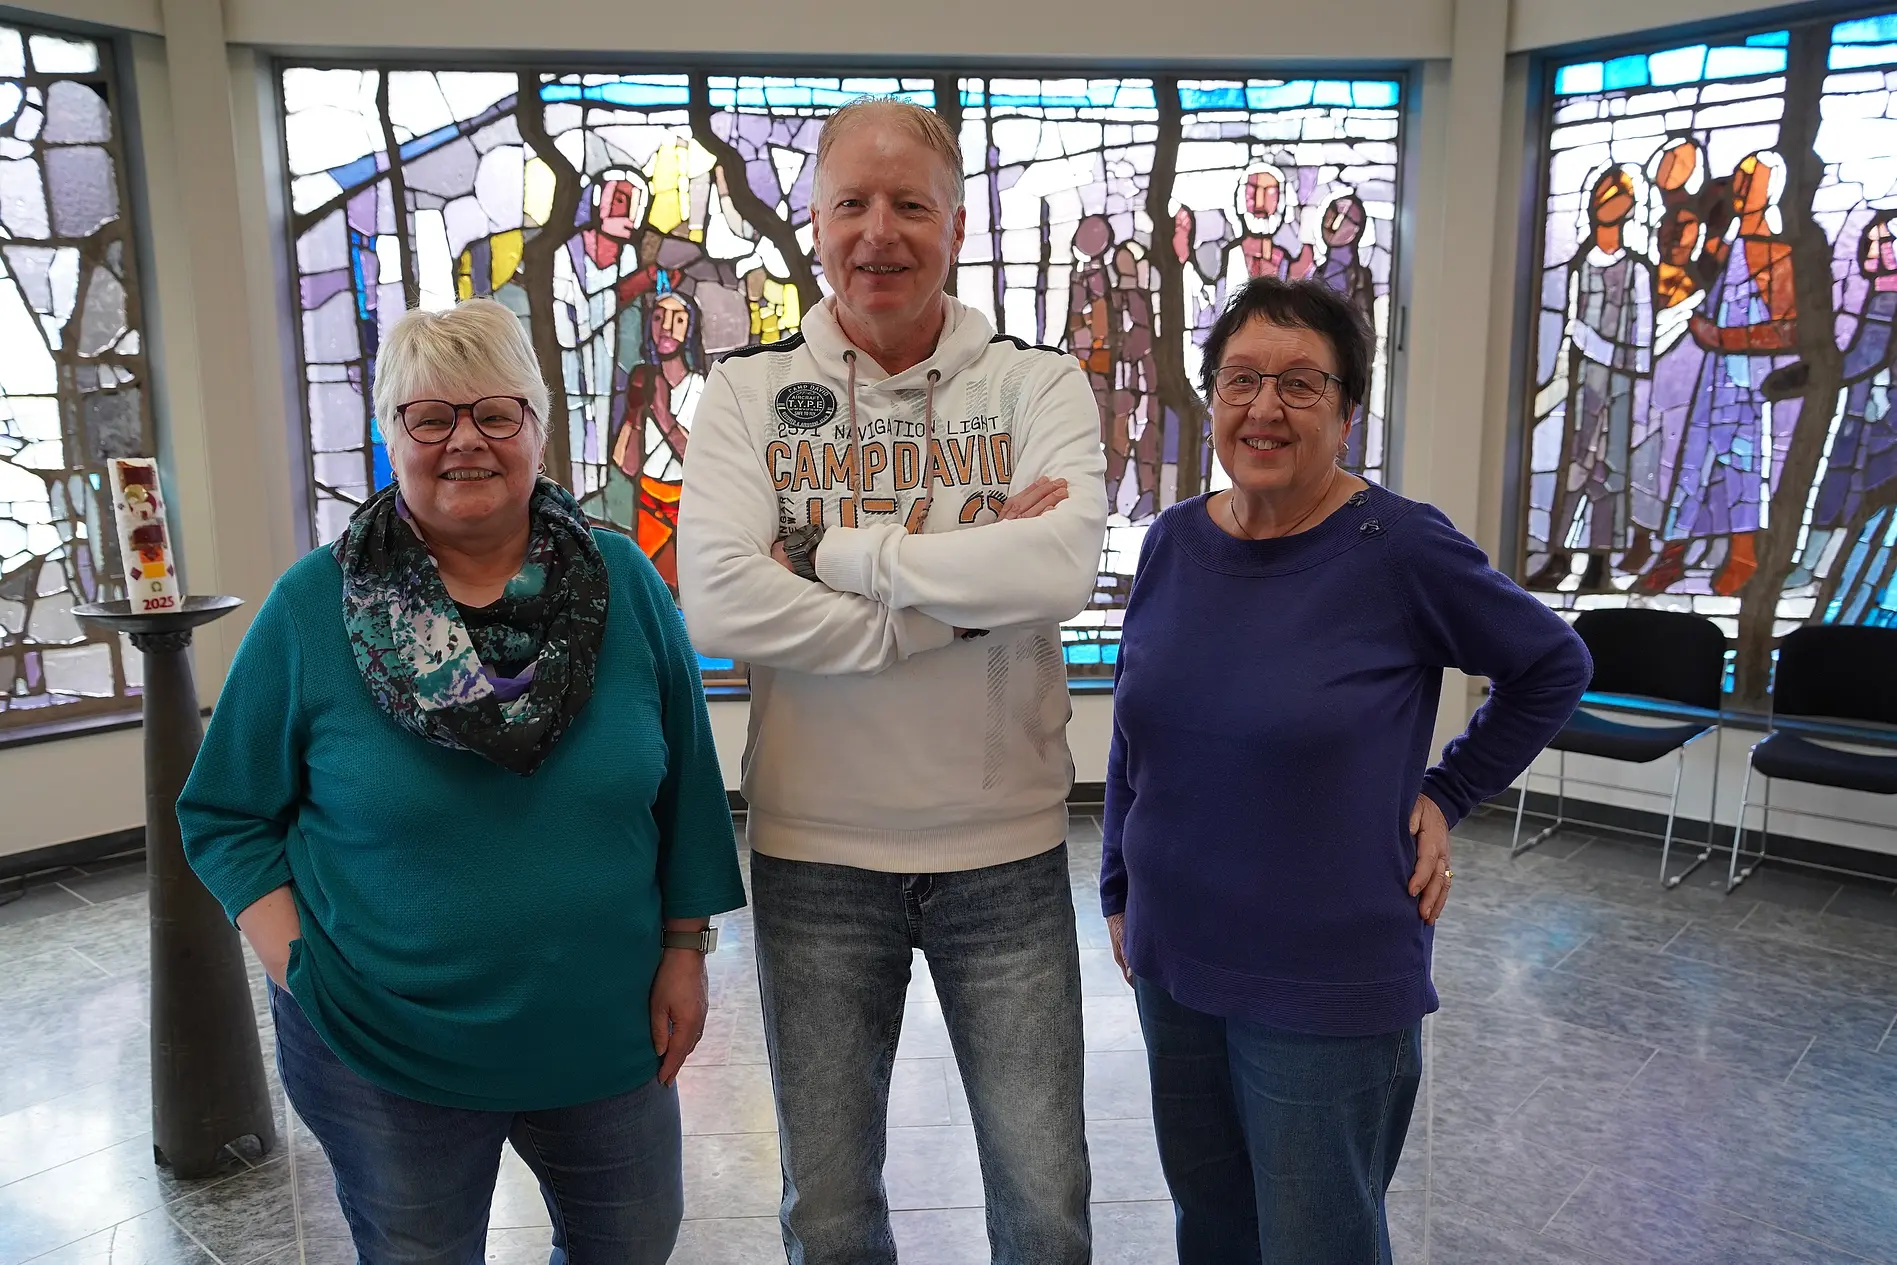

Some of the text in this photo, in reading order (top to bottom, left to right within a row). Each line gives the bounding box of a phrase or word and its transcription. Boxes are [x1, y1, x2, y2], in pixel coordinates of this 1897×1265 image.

[788, 400, 823, 409] T.Y.P.E
[834, 418, 935, 441] NAVIGATION
[947, 415, 999, 434] LIGHT
[142, 596, 175, 610] 2025
